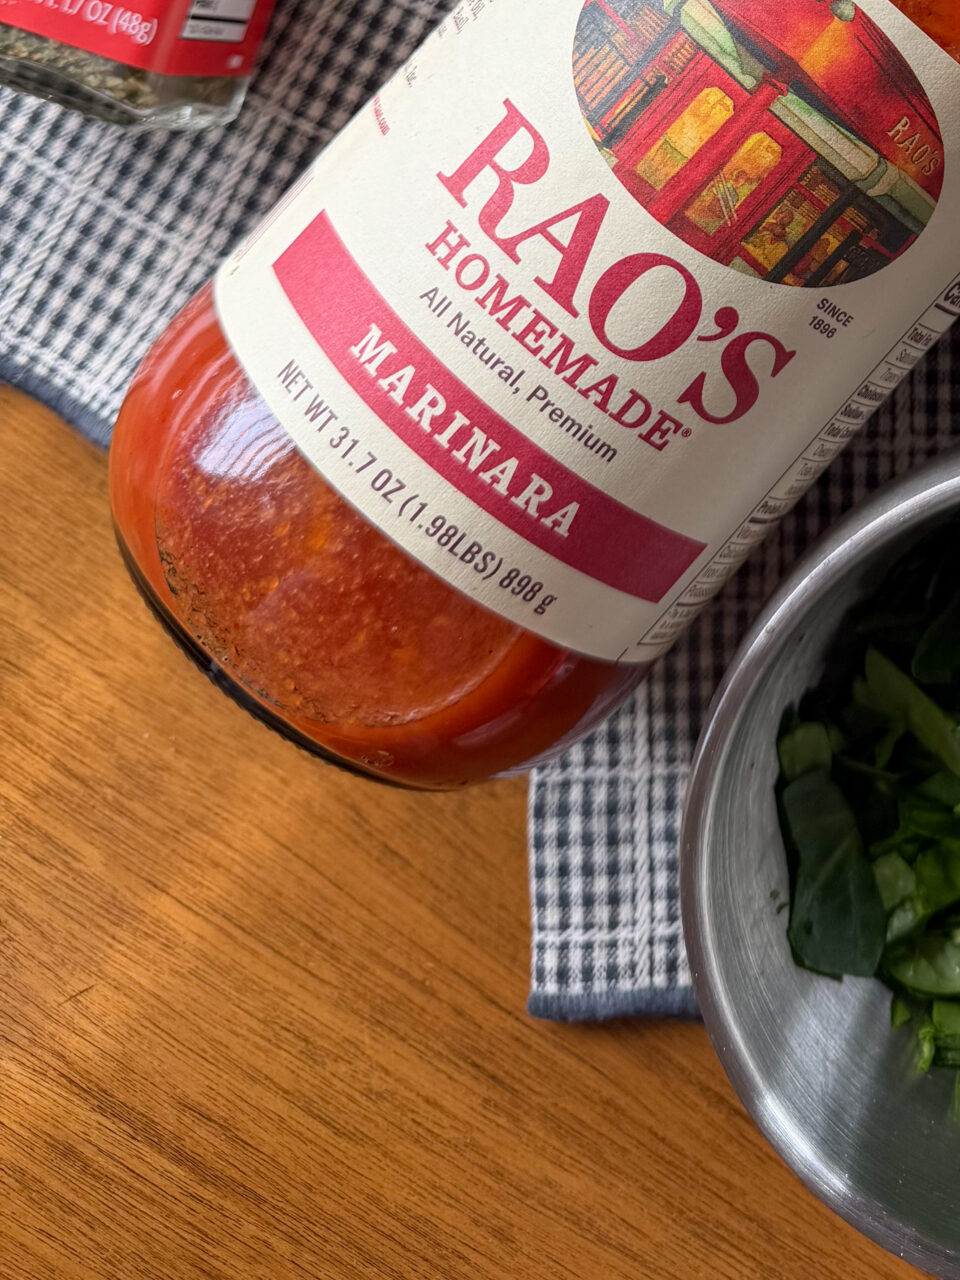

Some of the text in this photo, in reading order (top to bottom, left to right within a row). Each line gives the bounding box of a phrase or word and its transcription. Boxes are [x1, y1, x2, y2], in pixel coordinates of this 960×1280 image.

[84, 0, 114, 25] OZ
[109, 7, 158, 46] (48g)
[887, 116, 941, 176] RAO'S
[436, 98, 796, 424] RAO'S
[816, 298, 854, 328] SINCE
[420, 286, 618, 463] All Natural, Premium
[808, 316, 837, 339] 1896
[277, 359, 558, 615] NET WT 31.7 OZ (1.98LBS) 898 g
[350, 323, 581, 538] MARINARA
